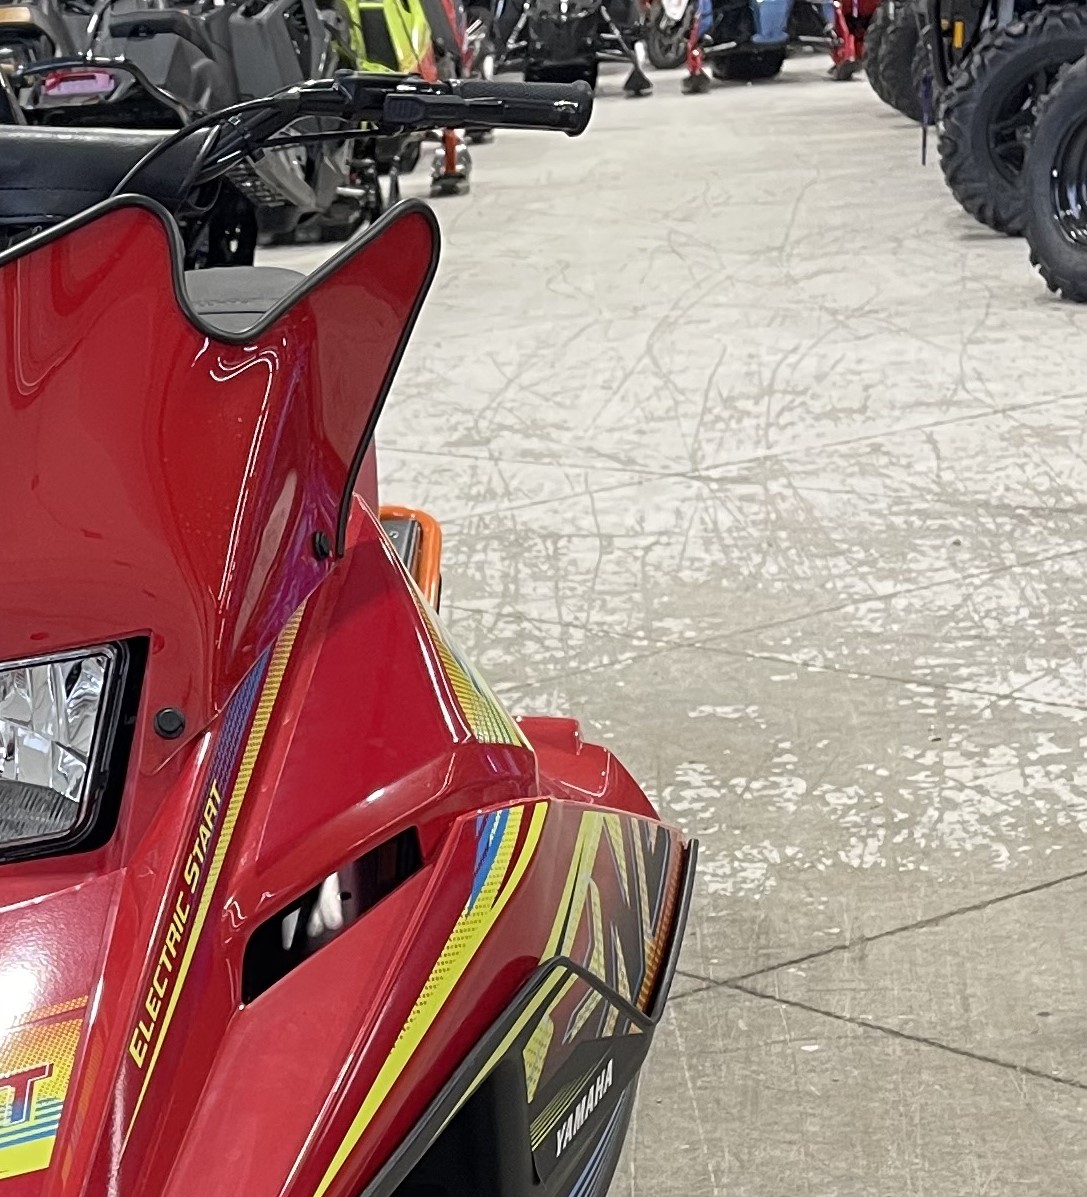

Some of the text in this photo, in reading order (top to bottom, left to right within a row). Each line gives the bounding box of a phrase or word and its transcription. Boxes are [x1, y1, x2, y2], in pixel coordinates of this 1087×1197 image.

[128, 779, 222, 1069] ELECTRIC START
[554, 1058, 614, 1159] YAMAHA
